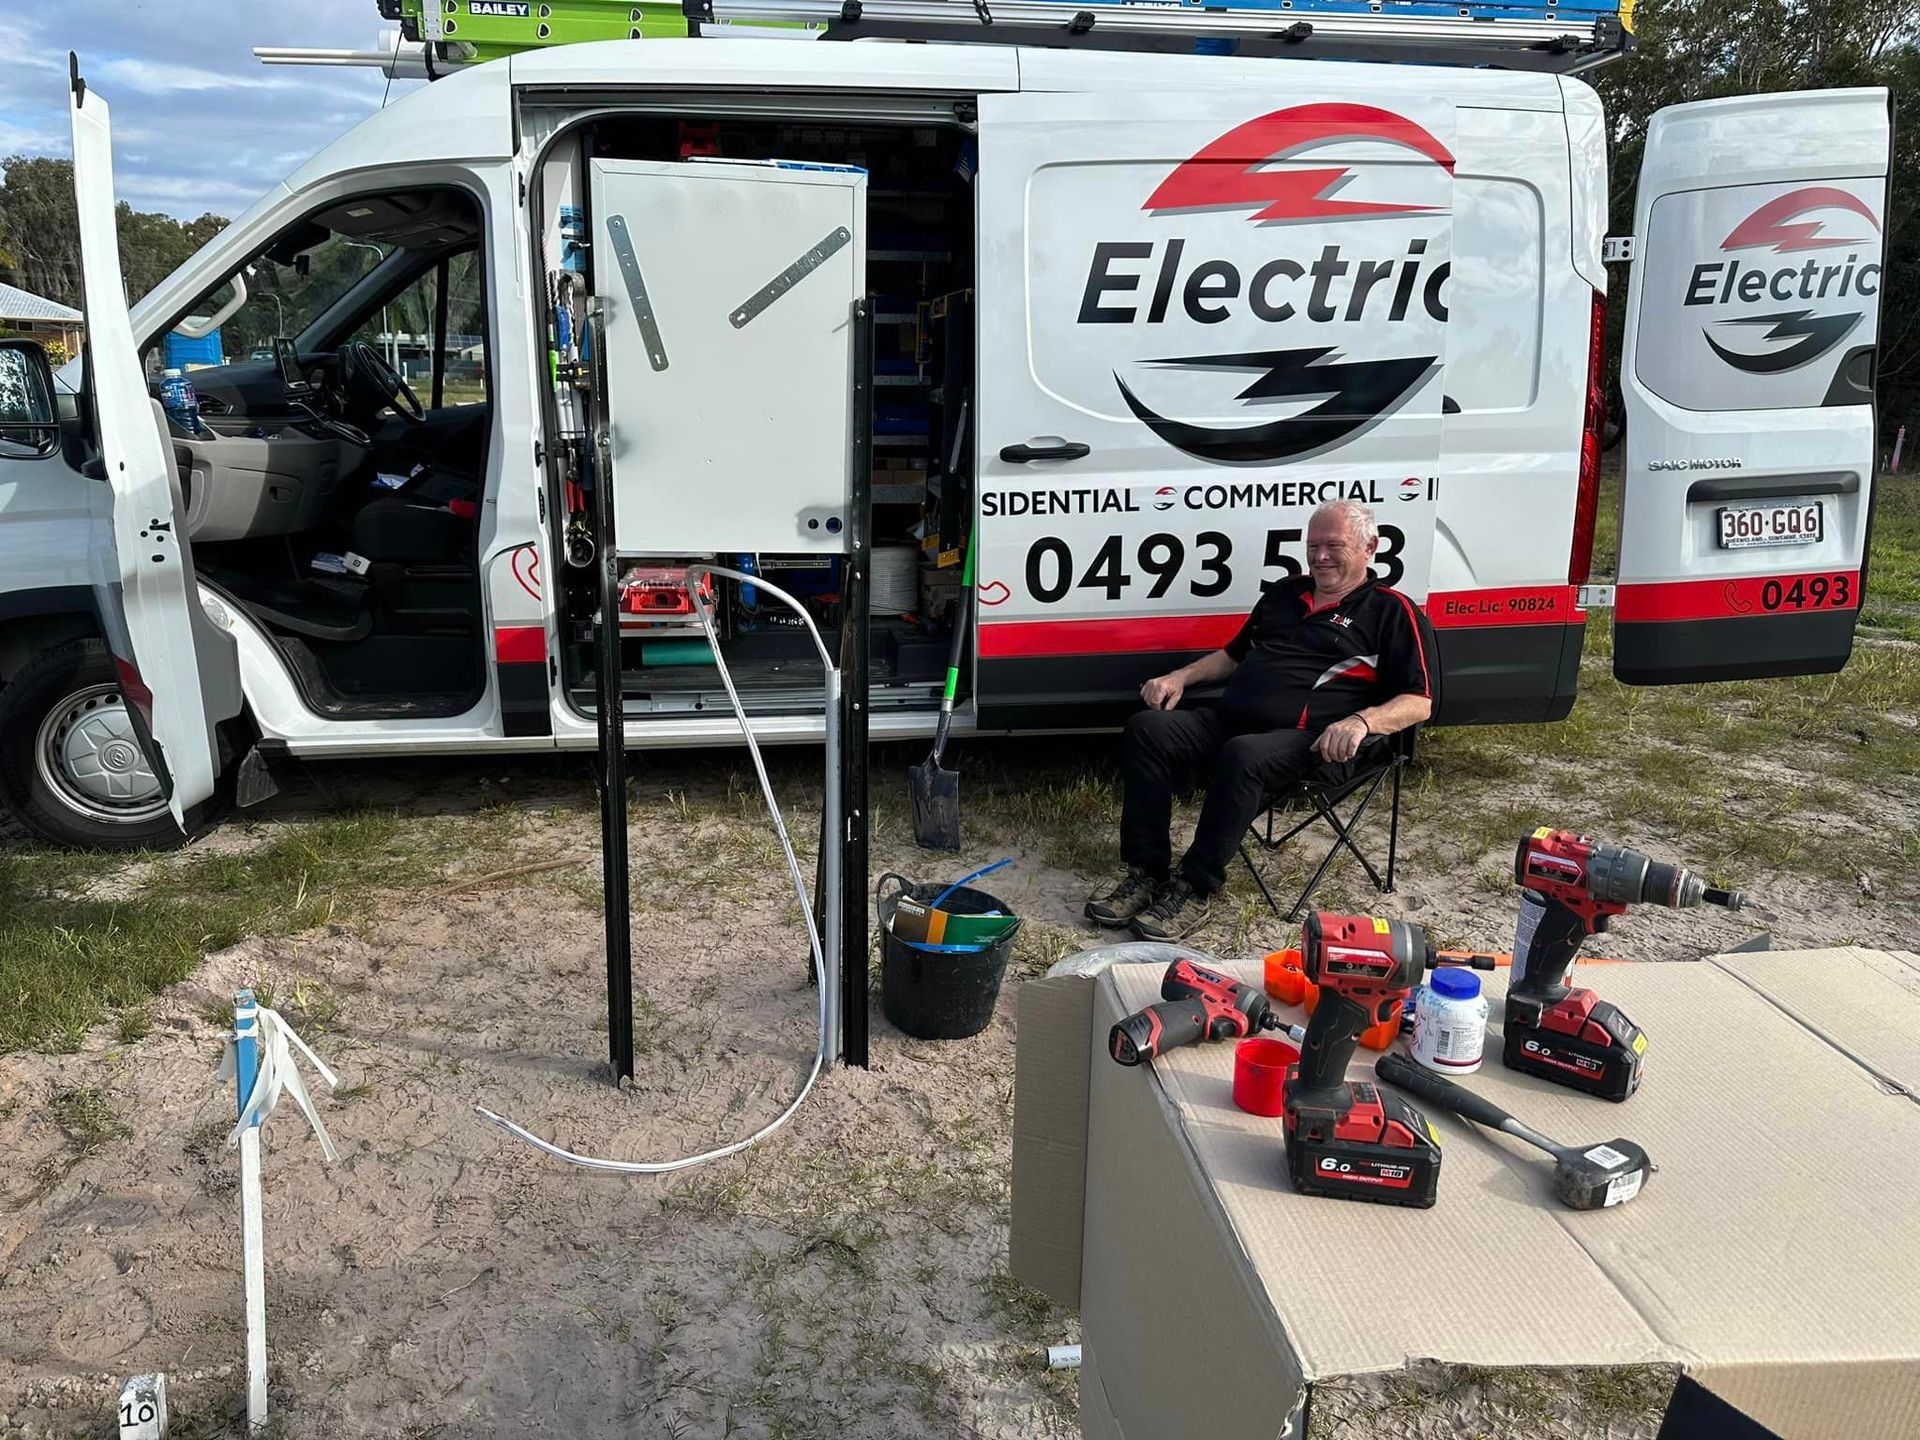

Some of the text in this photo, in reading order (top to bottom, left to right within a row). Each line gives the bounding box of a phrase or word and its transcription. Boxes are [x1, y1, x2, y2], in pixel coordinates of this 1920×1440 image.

[470, 2, 527, 16] BAILEY
[1684, 254, 1881, 306] Electric
[1647, 457, 1742, 472] SAIC MOTOR
[981, 488, 1141, 516] SIDENTIAL
[1183, 479, 1385, 511] COMMERCIAL
[1025, 530, 1233, 603] 0493
[1761, 575, 1849, 610] 0493
[1445, 600, 1475, 614] Elec
[1508, 597, 1555, 611] 90824
[1525, 1040, 1551, 1056] 6.0
[1320, 1157, 1351, 1172] 6.0
[121, 1402, 155, 1428] 10
